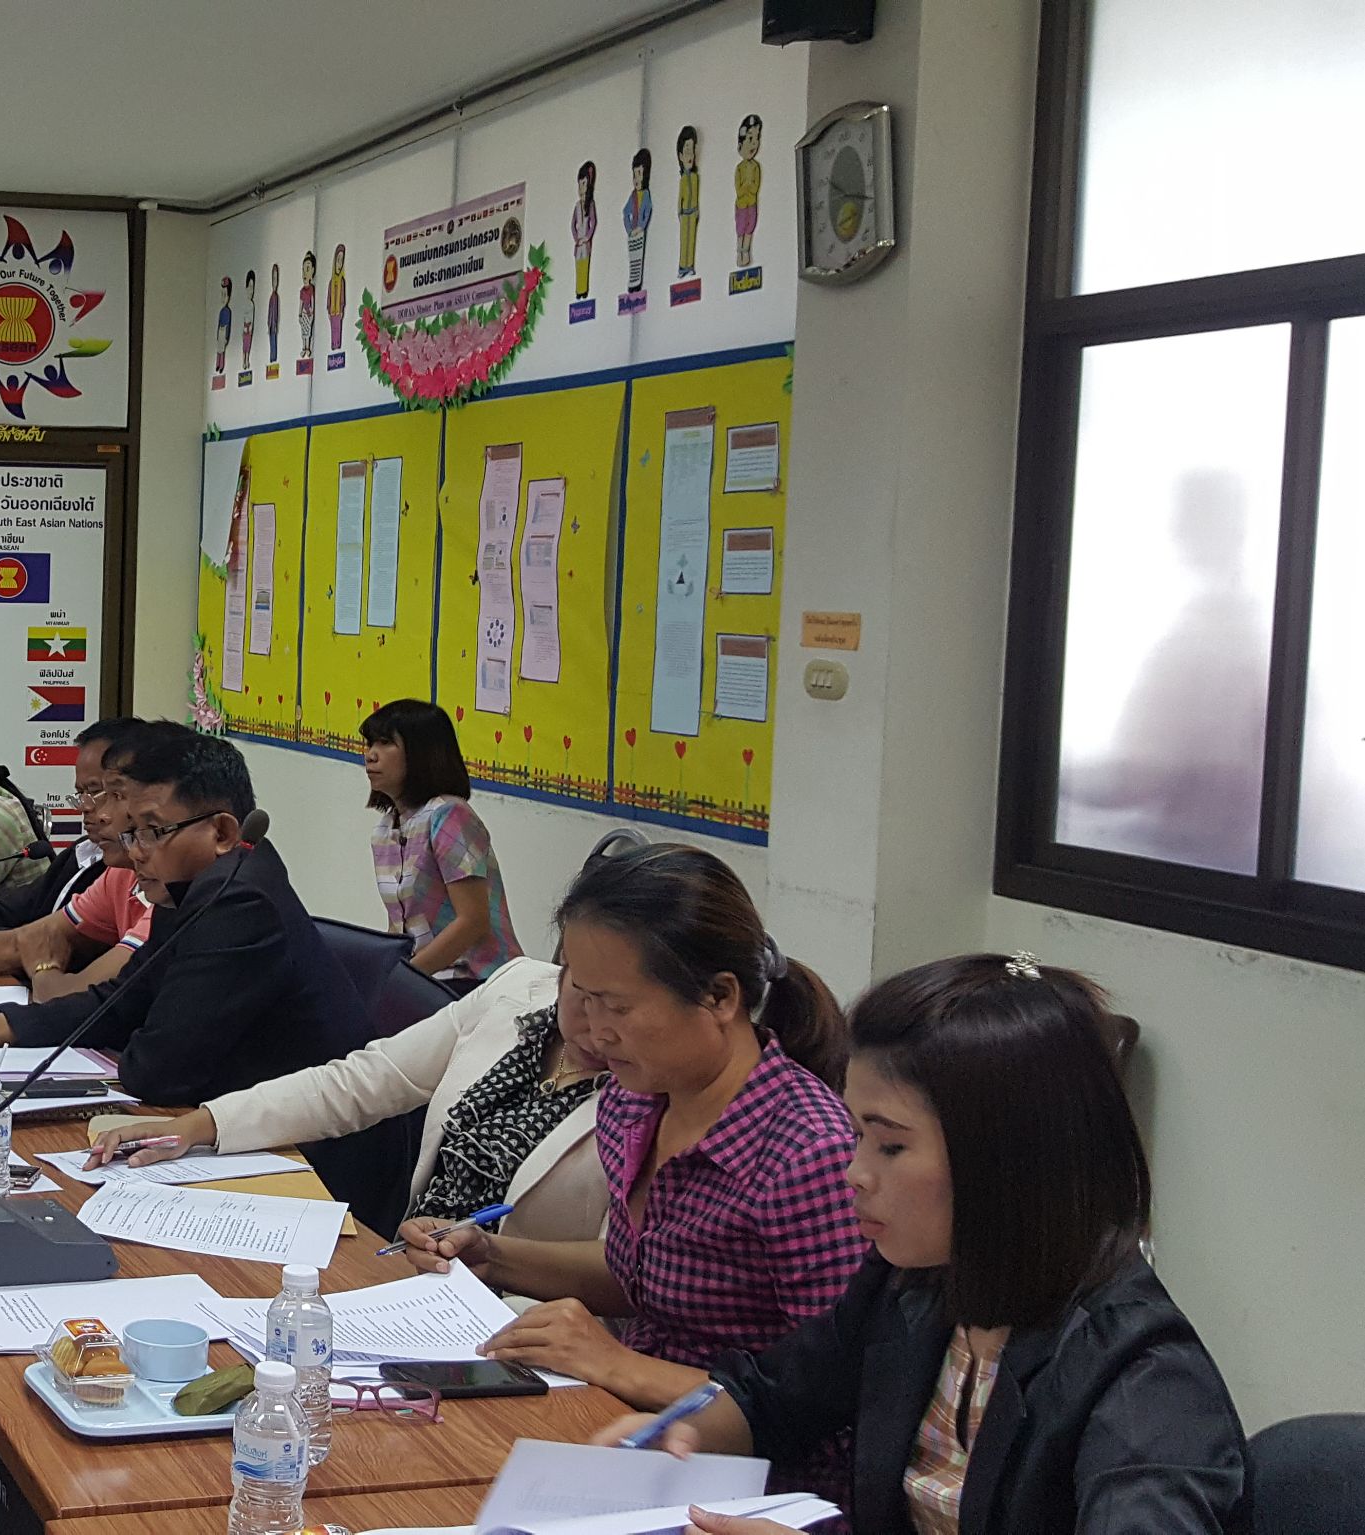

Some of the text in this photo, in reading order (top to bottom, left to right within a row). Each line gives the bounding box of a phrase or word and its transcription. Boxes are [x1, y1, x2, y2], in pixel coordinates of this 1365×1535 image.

[0, 269, 17, 280] Our
[19, 269, 46, 288] Future
[45, 283, 67, 323] Together
[15, 517, 37, 528] East
[39, 517, 66, 528] Asian
[68, 518, 104, 529] Nations
[50, 608, 66, 619] พม่า
[46, 792, 61, 802] ไทย
